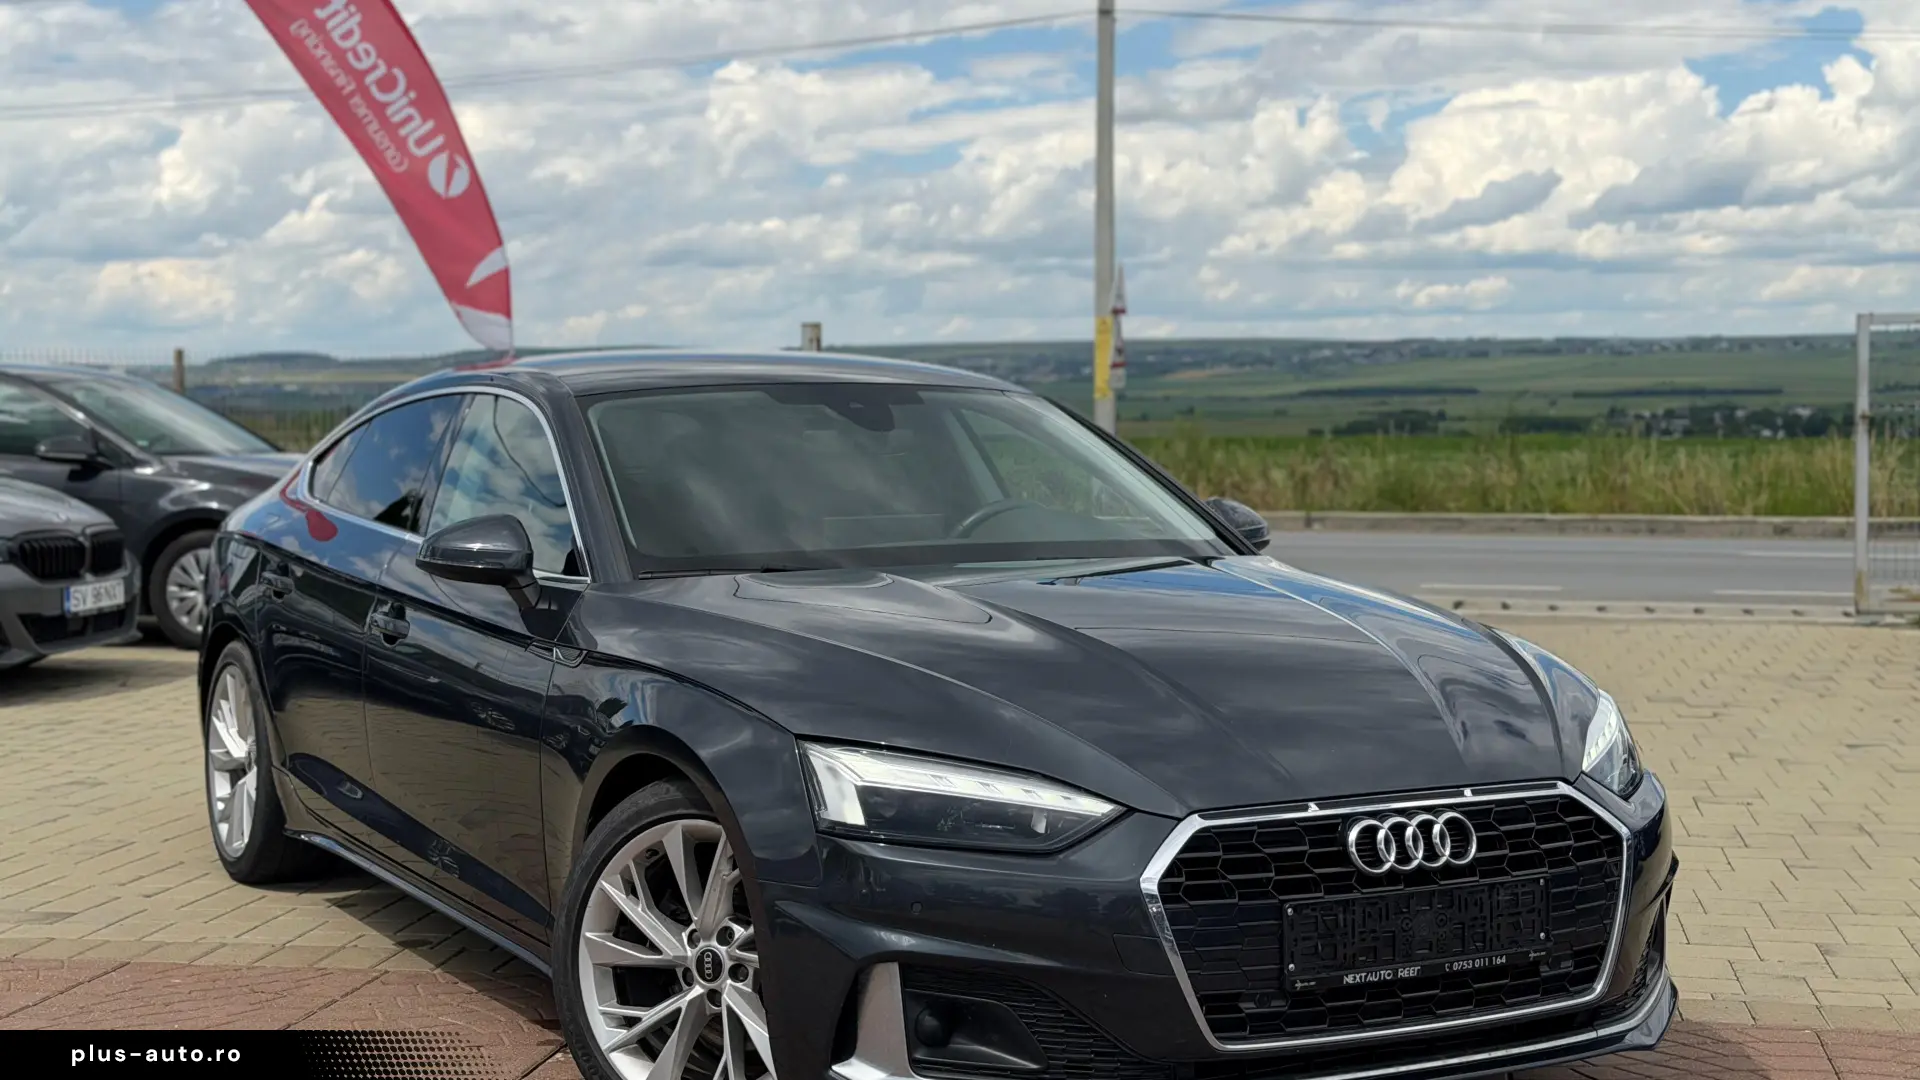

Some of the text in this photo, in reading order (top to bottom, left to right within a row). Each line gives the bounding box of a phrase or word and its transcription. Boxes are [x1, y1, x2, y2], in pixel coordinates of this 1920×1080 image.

[1453, 960, 1473, 971] 0753
[1474, 957, 1489, 968] 011
[1492, 954, 1506, 965] 164
